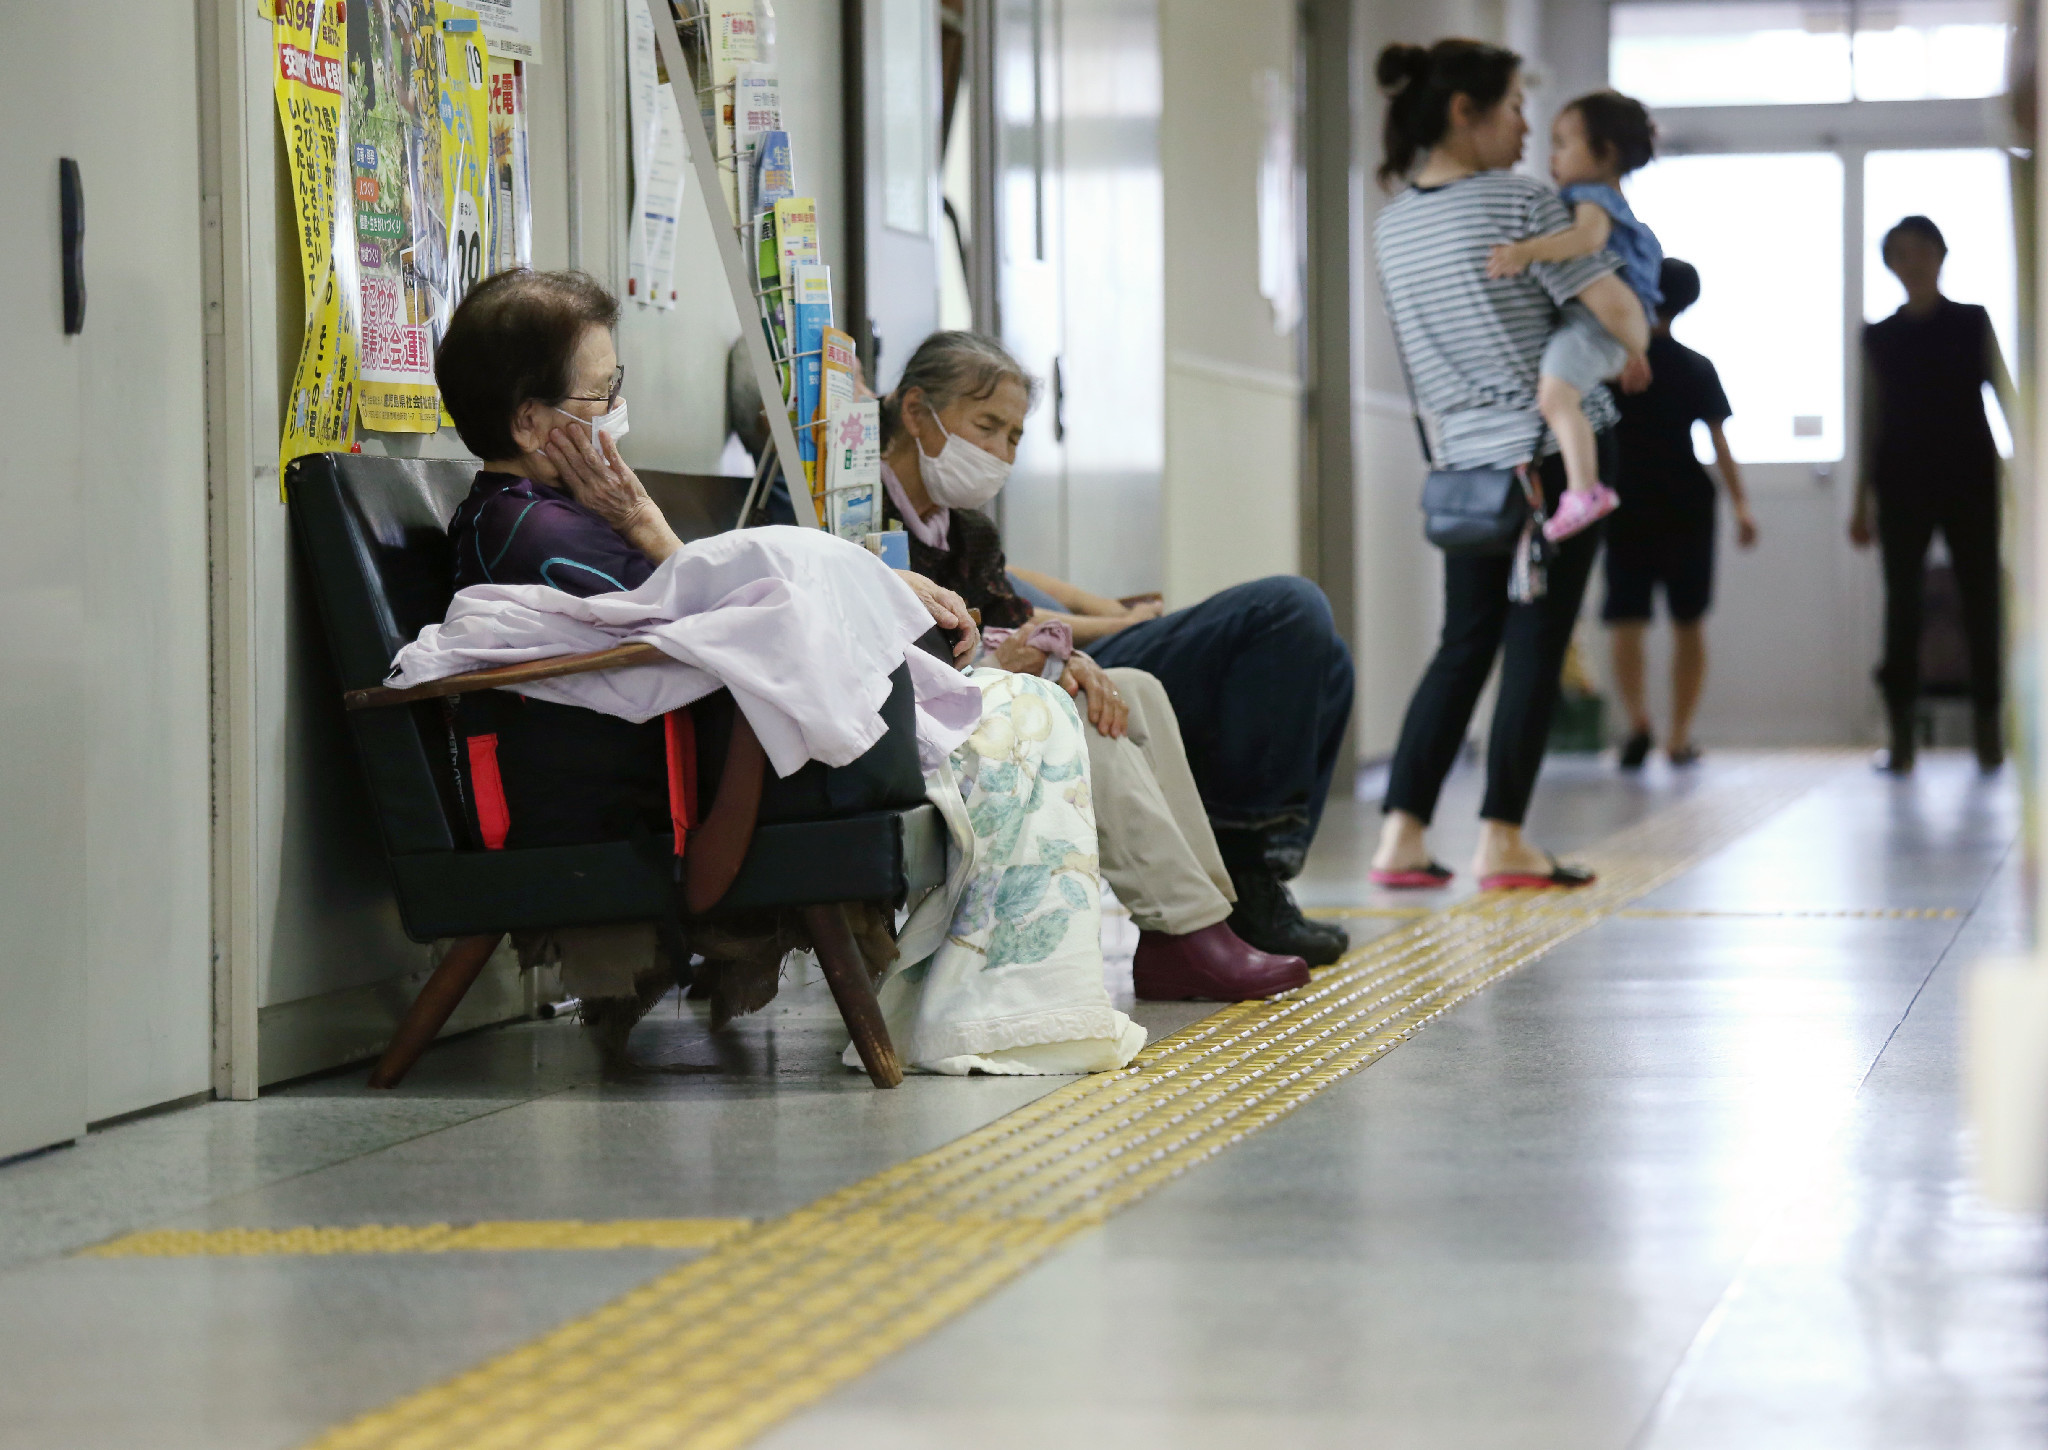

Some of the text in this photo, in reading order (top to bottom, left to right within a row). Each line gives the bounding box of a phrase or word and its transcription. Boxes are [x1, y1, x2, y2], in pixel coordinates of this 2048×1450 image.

[361, 323, 430, 372] 長寿社会運動
